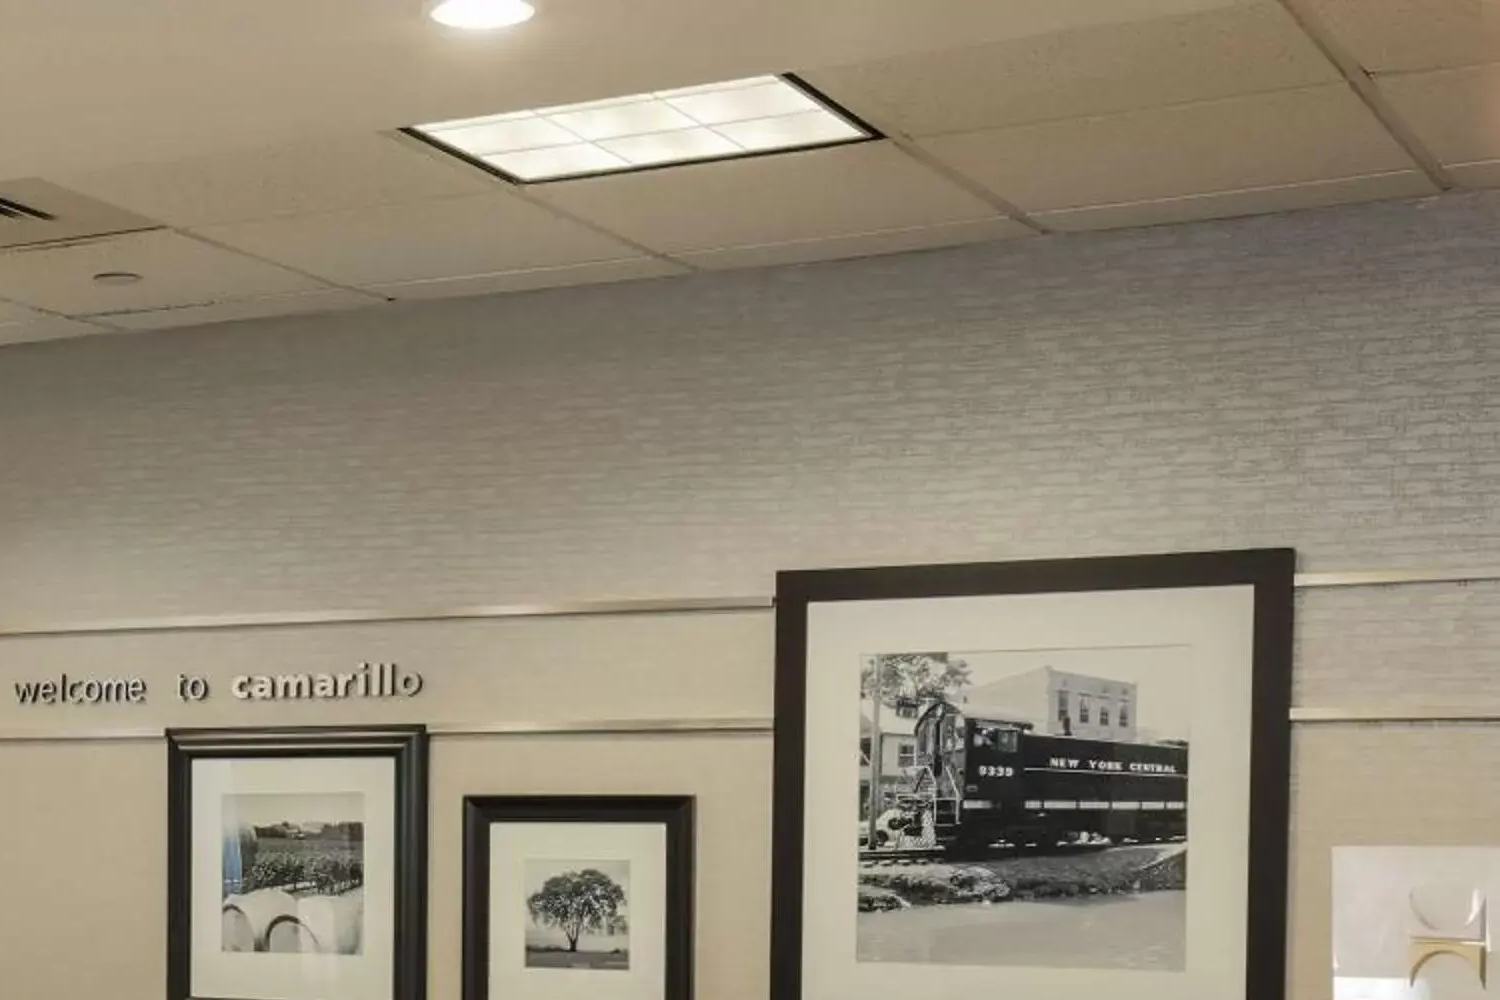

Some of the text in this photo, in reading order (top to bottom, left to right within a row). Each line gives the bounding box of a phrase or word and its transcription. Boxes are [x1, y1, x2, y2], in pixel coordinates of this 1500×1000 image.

[14, 663, 424, 703] welcome to camarillo
[1049, 756, 1177, 773] NEW YORK CENTRAL
